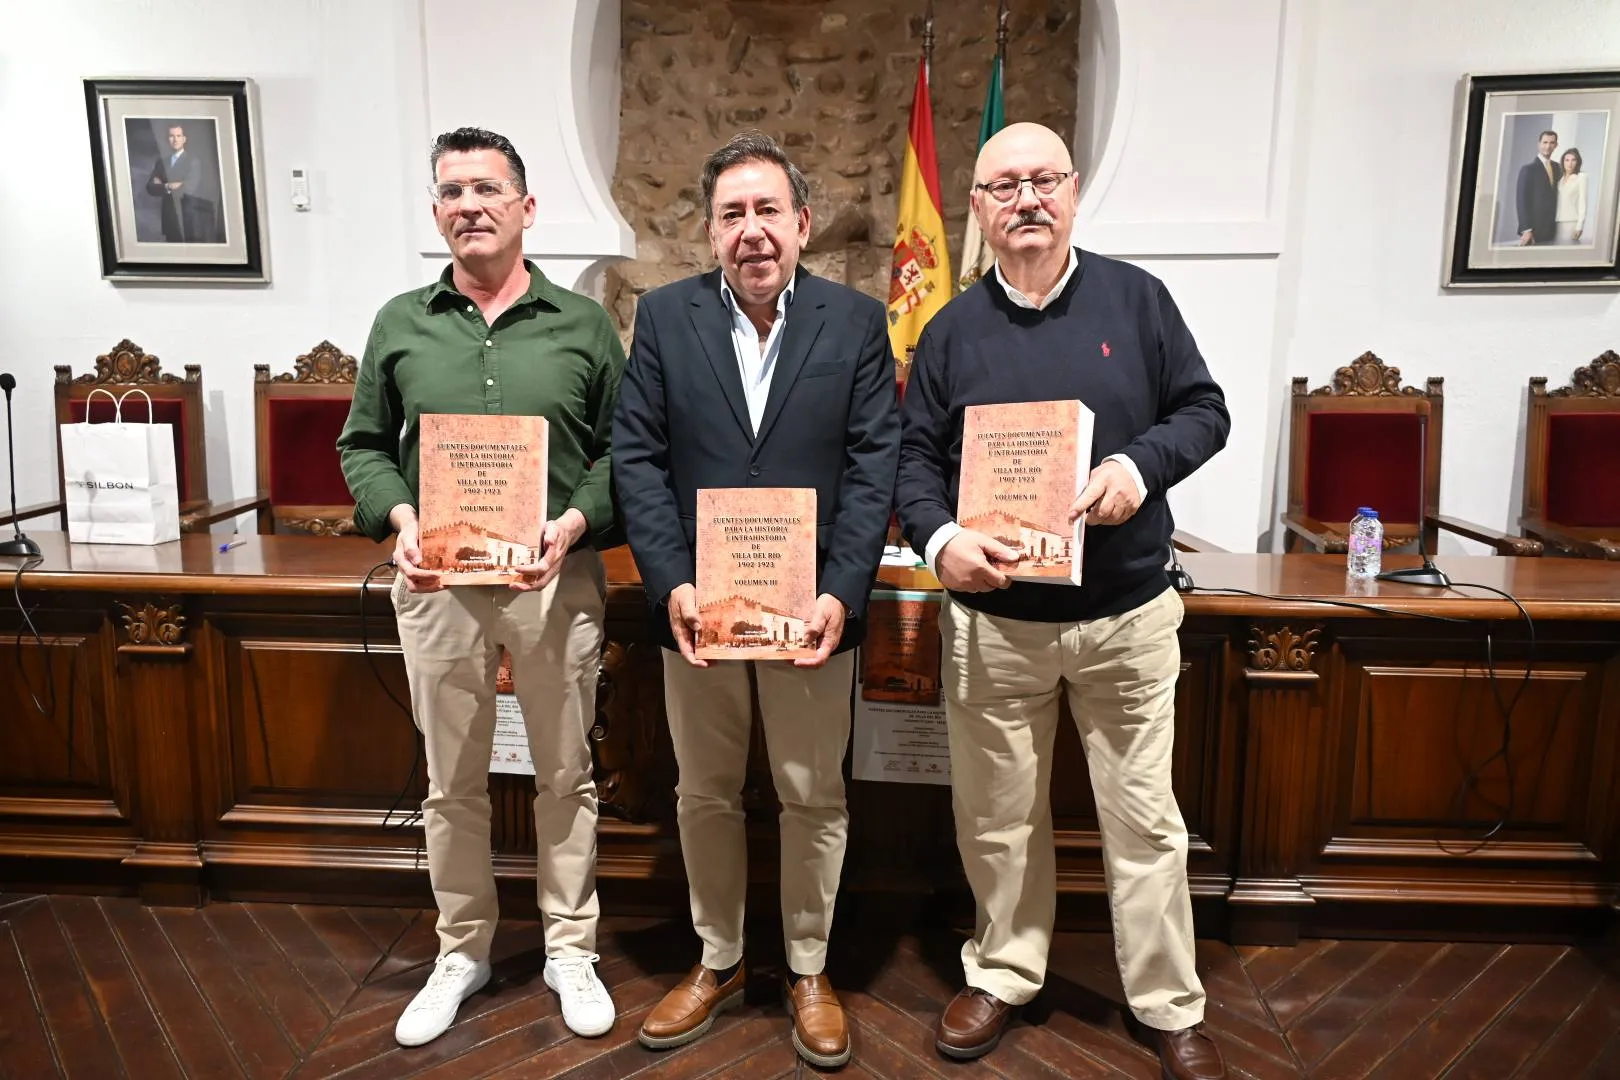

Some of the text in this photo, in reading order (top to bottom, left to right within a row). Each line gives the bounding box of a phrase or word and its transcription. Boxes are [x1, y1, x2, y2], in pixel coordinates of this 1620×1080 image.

[977, 430, 1062, 440] FUENTES DOCUMENTALES
[1016, 439, 1050, 447] HISTORIA
[449, 452, 469, 460] PARA
[994, 448, 1048, 456] INTRAHISTORIA
[456, 461, 513, 469] INTRAHISTORIA
[86, 481, 134, 490] SILBON
[713, 517, 801, 525] FUENTES DOCUMENTALES
[731, 534, 787, 542] INTRAHISTORIA
